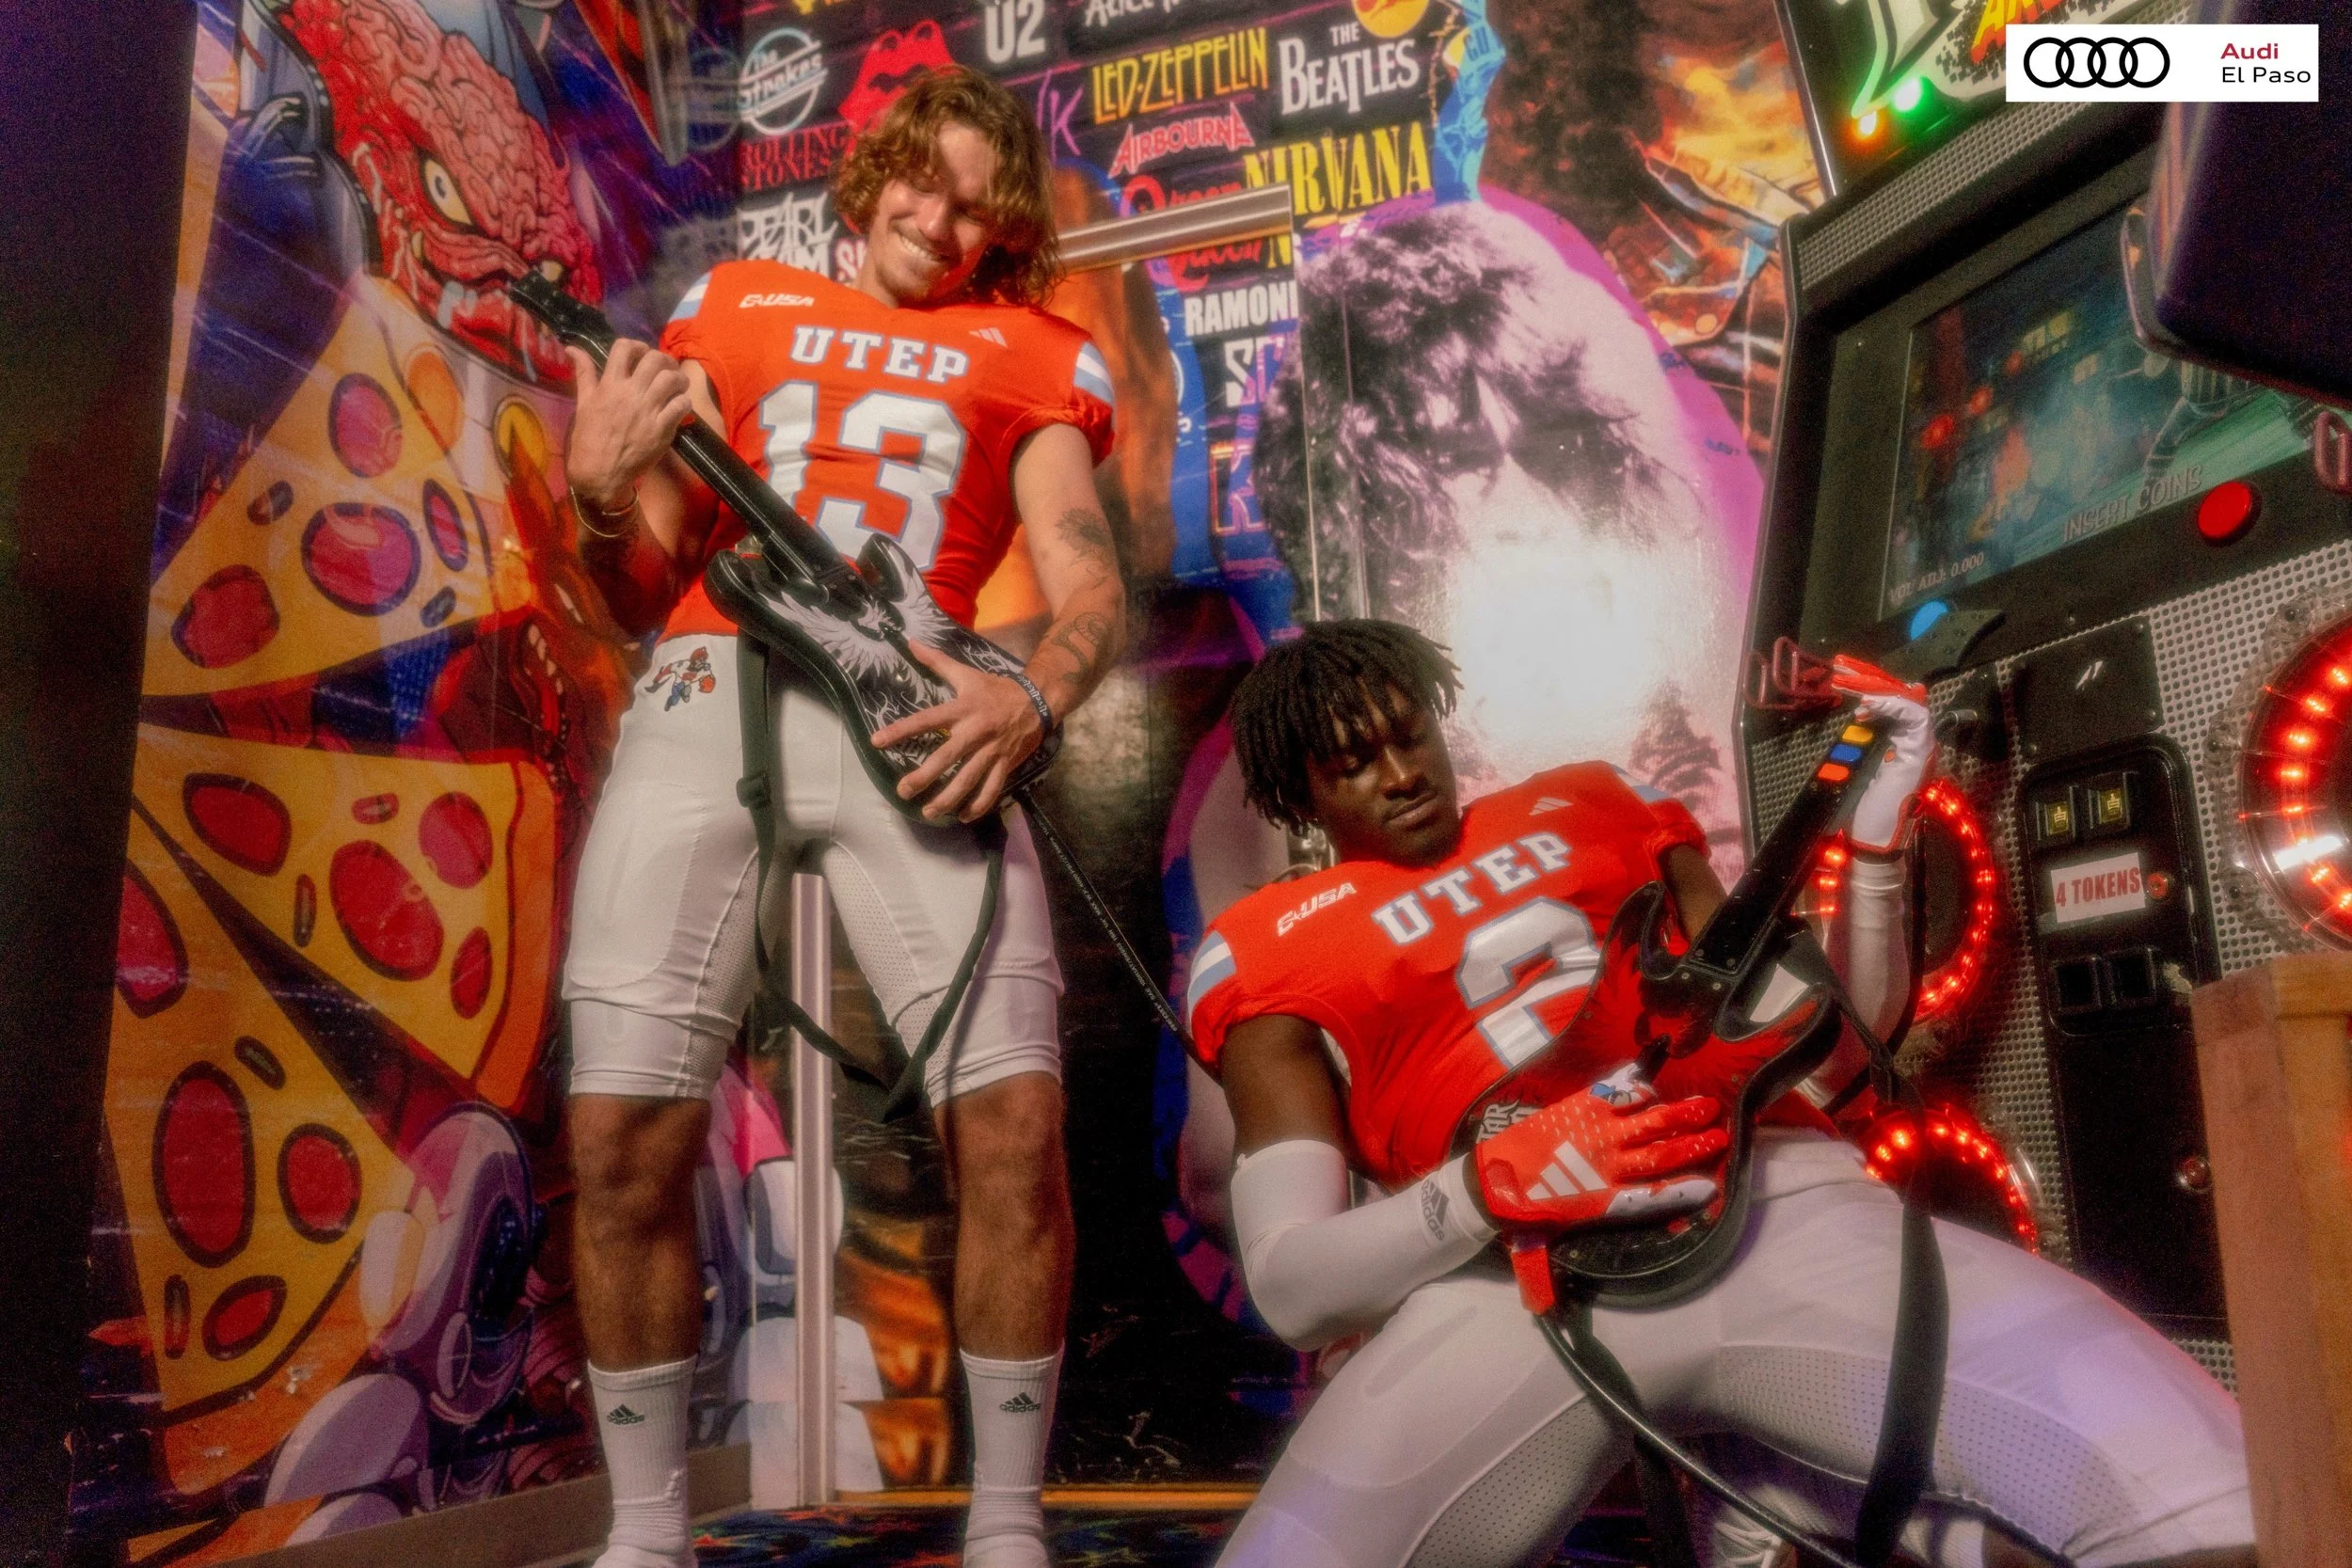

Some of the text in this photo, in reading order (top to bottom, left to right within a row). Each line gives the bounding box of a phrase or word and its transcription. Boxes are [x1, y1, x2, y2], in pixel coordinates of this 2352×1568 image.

[985, 0, 1045, 64] U2
[1329, 22, 1360, 47] THE
[1278, 38, 1421, 116] BEATLES
[1106, 100, 1256, 179] AIRBOURNE
[1243, 120, 1431, 215] NIRVANA
[790, 325, 969, 384] UTEP
[758, 380, 965, 571] 13
[2062, 466, 2202, 543] INSERT COINS
[1371, 831, 1575, 945] UTEP
[2056, 866, 2140, 907] 4 TOKENS
[1455, 895, 1604, 1068] 2
